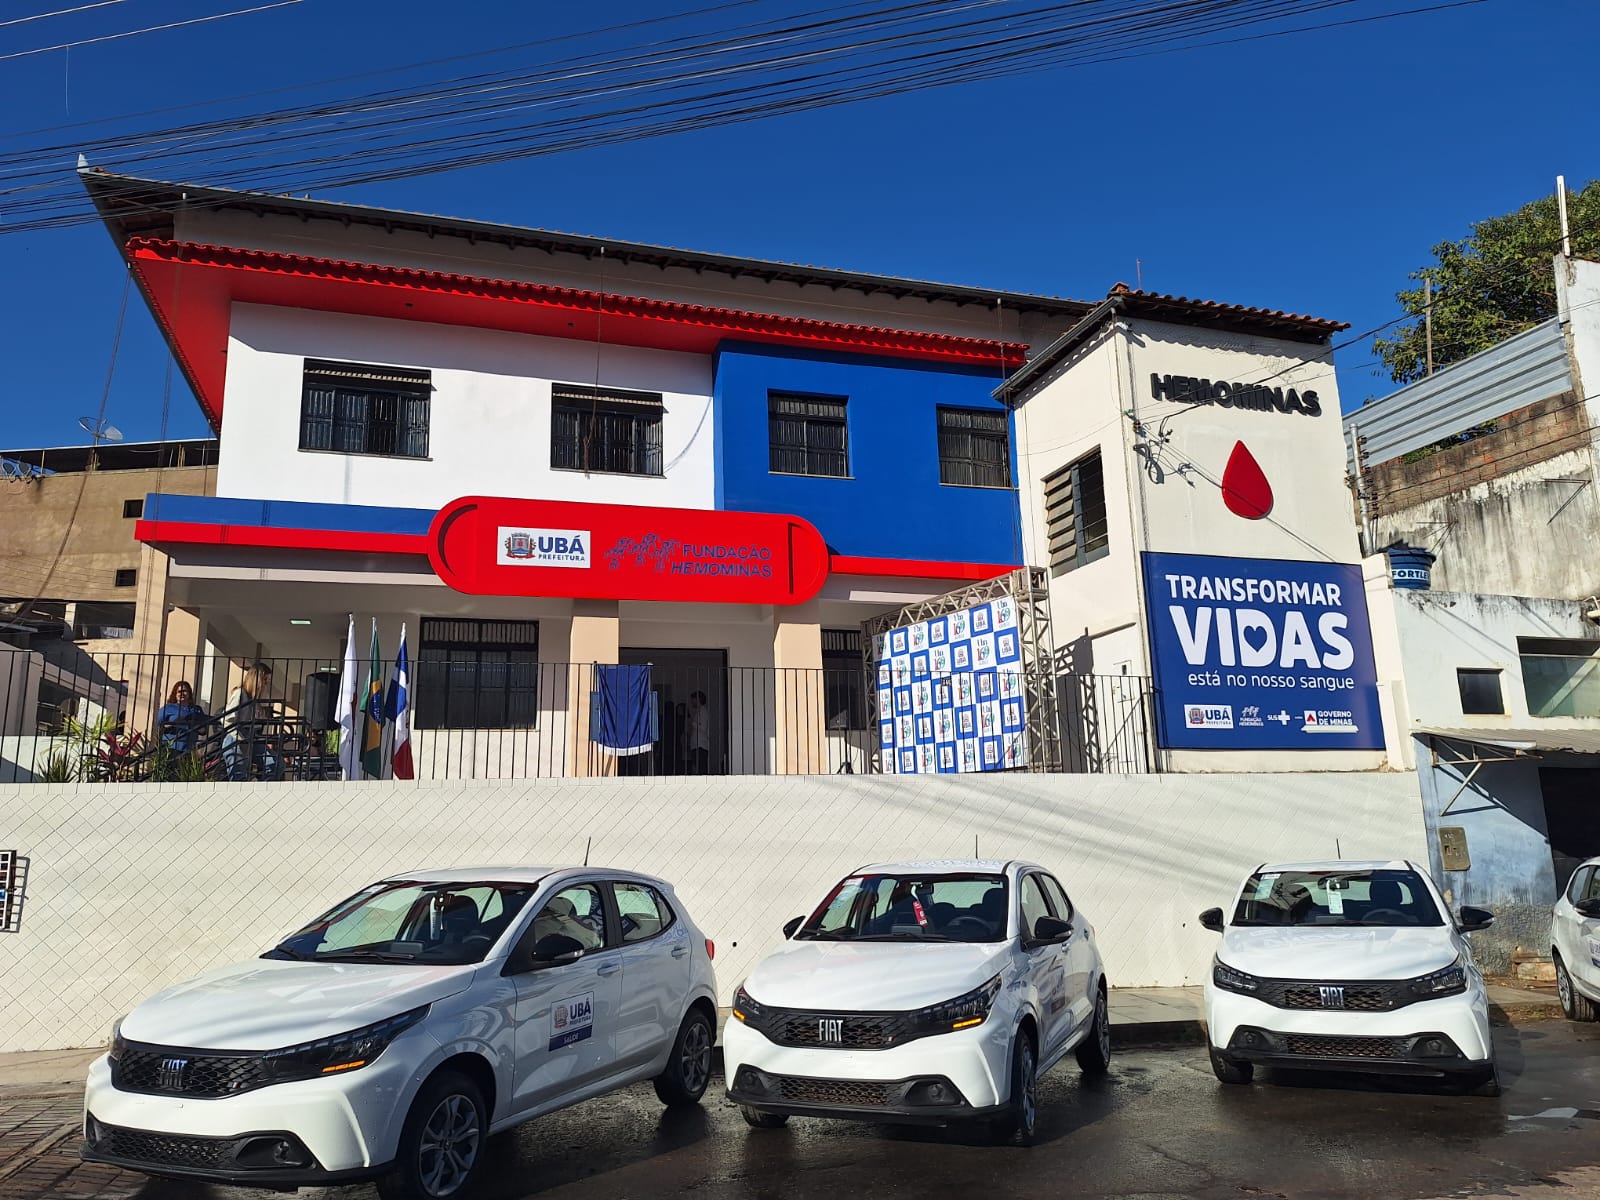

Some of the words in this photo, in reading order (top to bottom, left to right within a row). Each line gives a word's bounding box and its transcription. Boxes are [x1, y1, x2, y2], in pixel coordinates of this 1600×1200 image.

[1150, 373, 1321, 417] HEMOMINAS
[538, 535, 584, 555] UBÁ
[683, 544, 771, 560] FUNDAÇÃO
[537, 553, 586, 562] PREFEITURA
[670, 560, 772, 578] HEMOMINAS
[1165, 574, 1342, 606] TRANSFORMAR
[1169, 605, 1354, 670] VIDAS
[1188, 670, 1221, 686] está
[1226, 674, 1247, 687] no
[1251, 675, 1296, 688] nosso
[1300, 677, 1355, 692] sangue
[1205, 707, 1231, 721] UBÁ
[1331, 719, 1353, 727] MINAS
[1319, 986, 1344, 1006] FIAT
[570, 997, 591, 1020] UBÁ
[819, 1019, 844, 1042] FIAT
